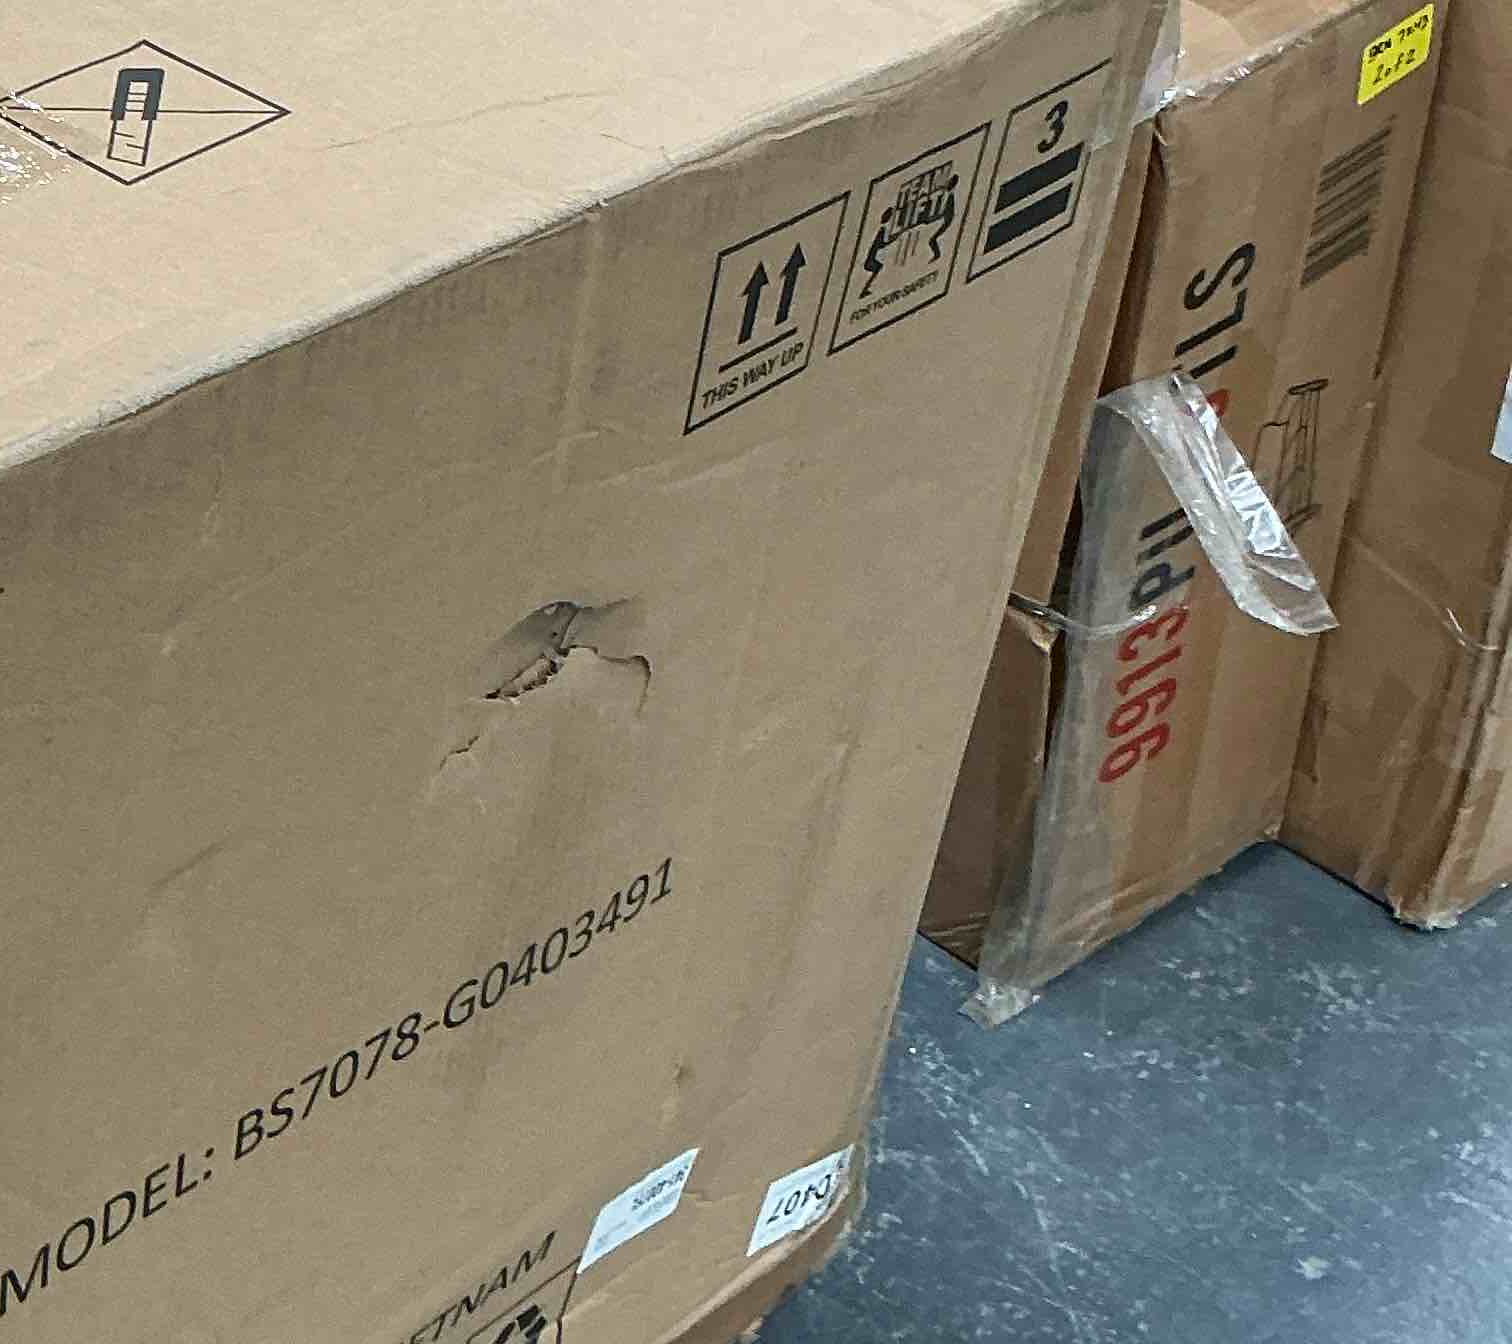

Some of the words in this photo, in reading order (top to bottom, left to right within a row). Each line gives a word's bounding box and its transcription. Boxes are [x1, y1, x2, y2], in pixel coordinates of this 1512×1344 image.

[1036, 99, 1069, 154] 3
[700, 376, 738, 410] THIS
[742, 359, 778, 394] WAY
[779, 341, 804, 374] UP
[233, 857, 674, 1160] BS7078-G0403491
